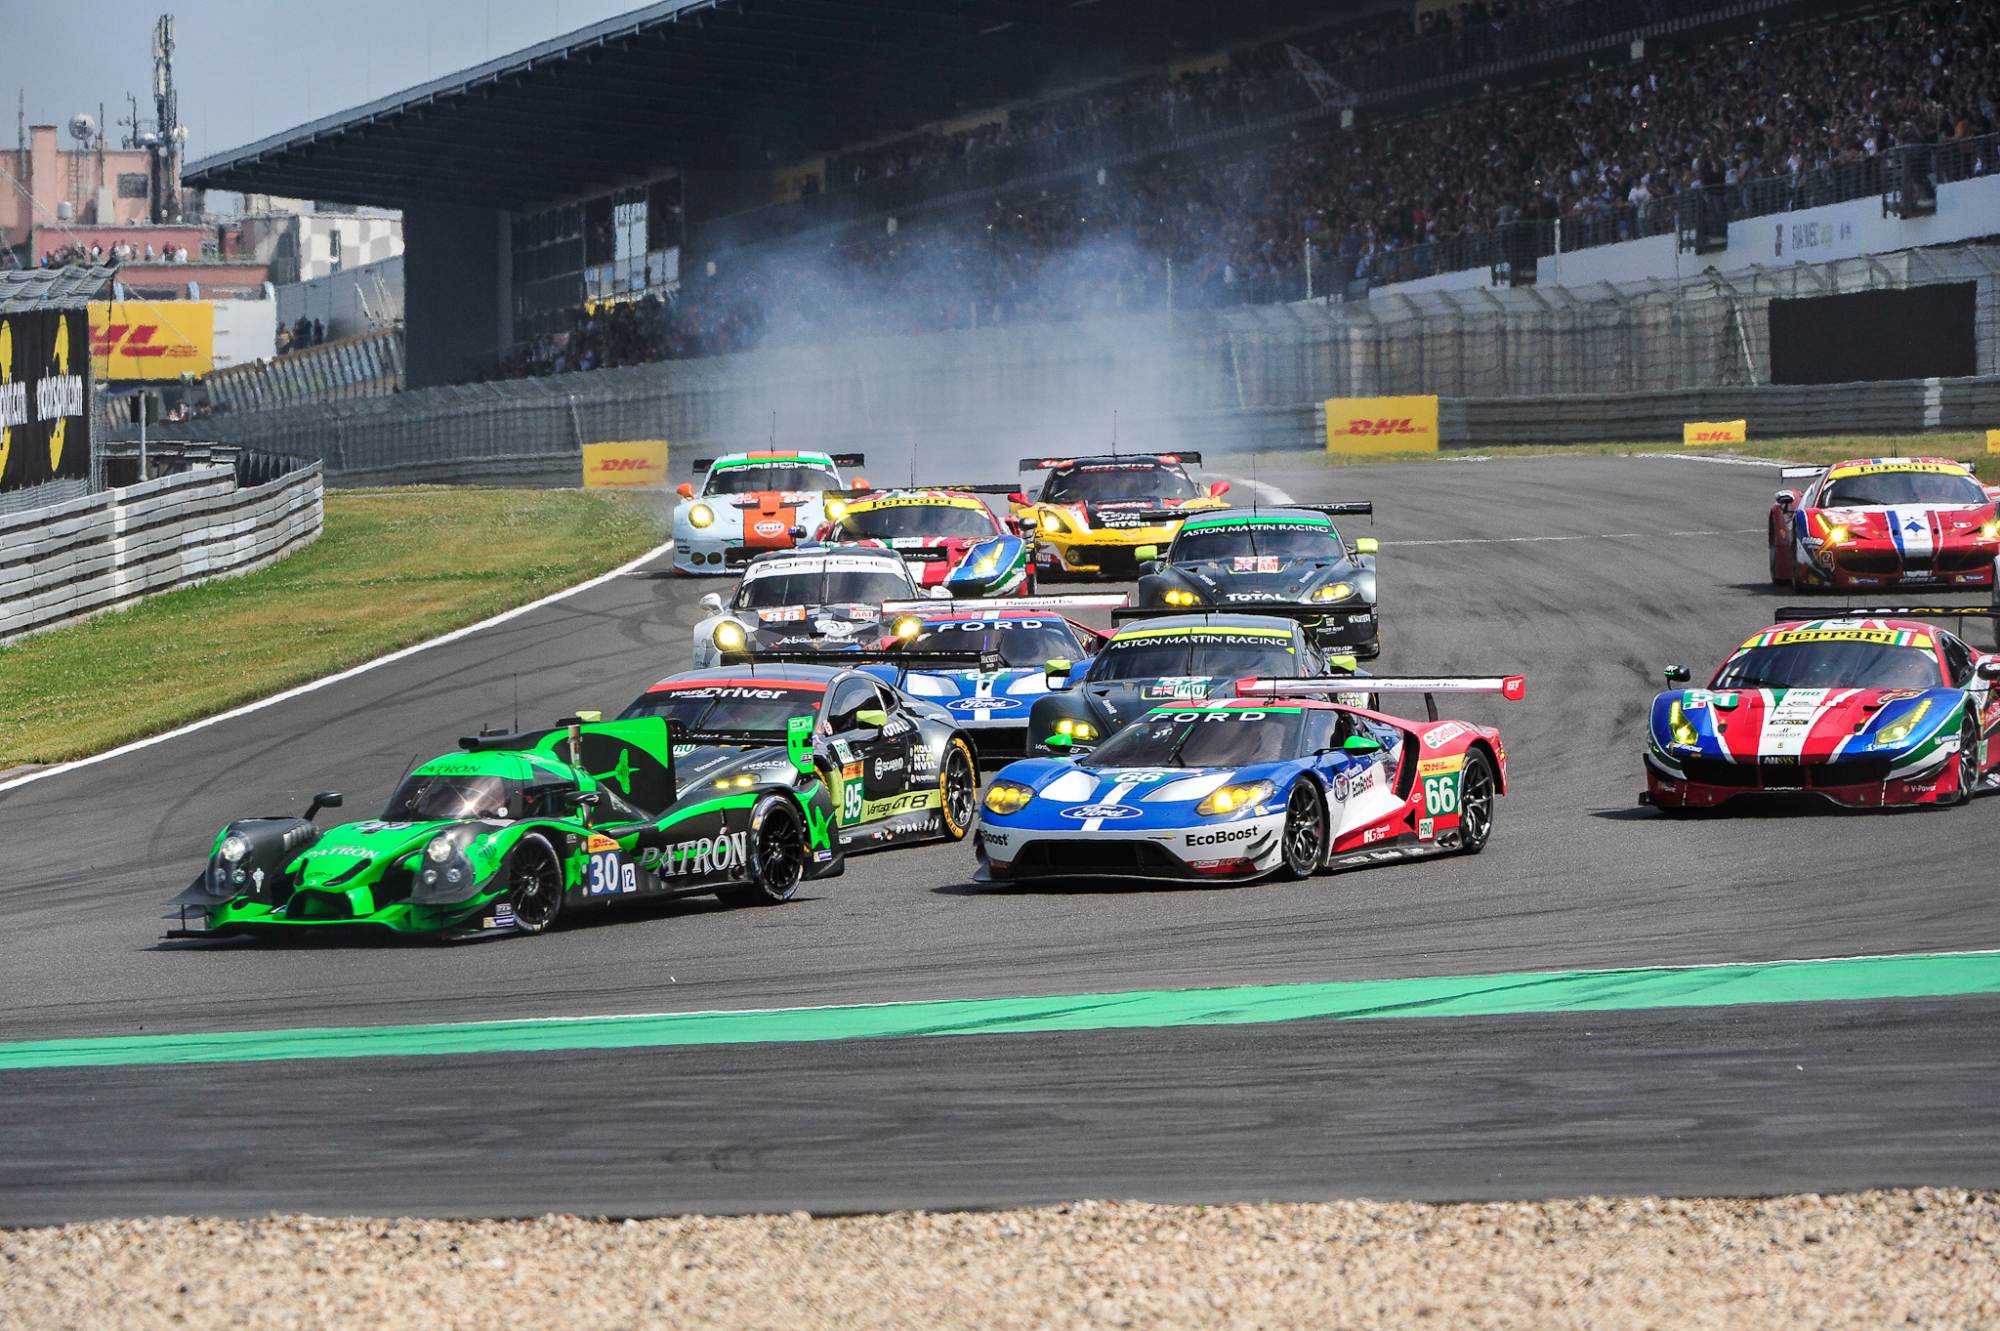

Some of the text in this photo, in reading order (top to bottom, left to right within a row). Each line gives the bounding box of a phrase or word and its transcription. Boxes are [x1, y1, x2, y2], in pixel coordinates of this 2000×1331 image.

[1348, 419, 1415, 435] DHL
[1695, 431, 1733, 441] DHL
[600, 459, 650, 471] DHL
[1860, 464, 1942, 473] Ferrari
[872, 499, 953, 509] Ferrari
[1183, 523, 1329, 538] ASTON MARTIN RACING
[1225, 593, 1287, 602] TOTAL
[937, 620, 1043, 633] FORD
[1111, 634, 1288, 650] ASTON MARTIN RACING
[1781, 631, 1893, 643] Ferrari
[958, 698, 1007, 709] Ford
[1150, 712, 1267, 723] FORD
[1113, 771, 1165, 783] 66
[844, 782, 863, 820] 95
[1425, 776, 1456, 816] 66
[867, 802, 892, 816] Vantage
[1073, 805, 1128, 818] Ford
[1185, 825, 1260, 847] EcoBoost
[1420, 823, 1433, 837] PRO
[638, 827, 748, 878] PATRÓN
[590, 854, 619, 893] 30
